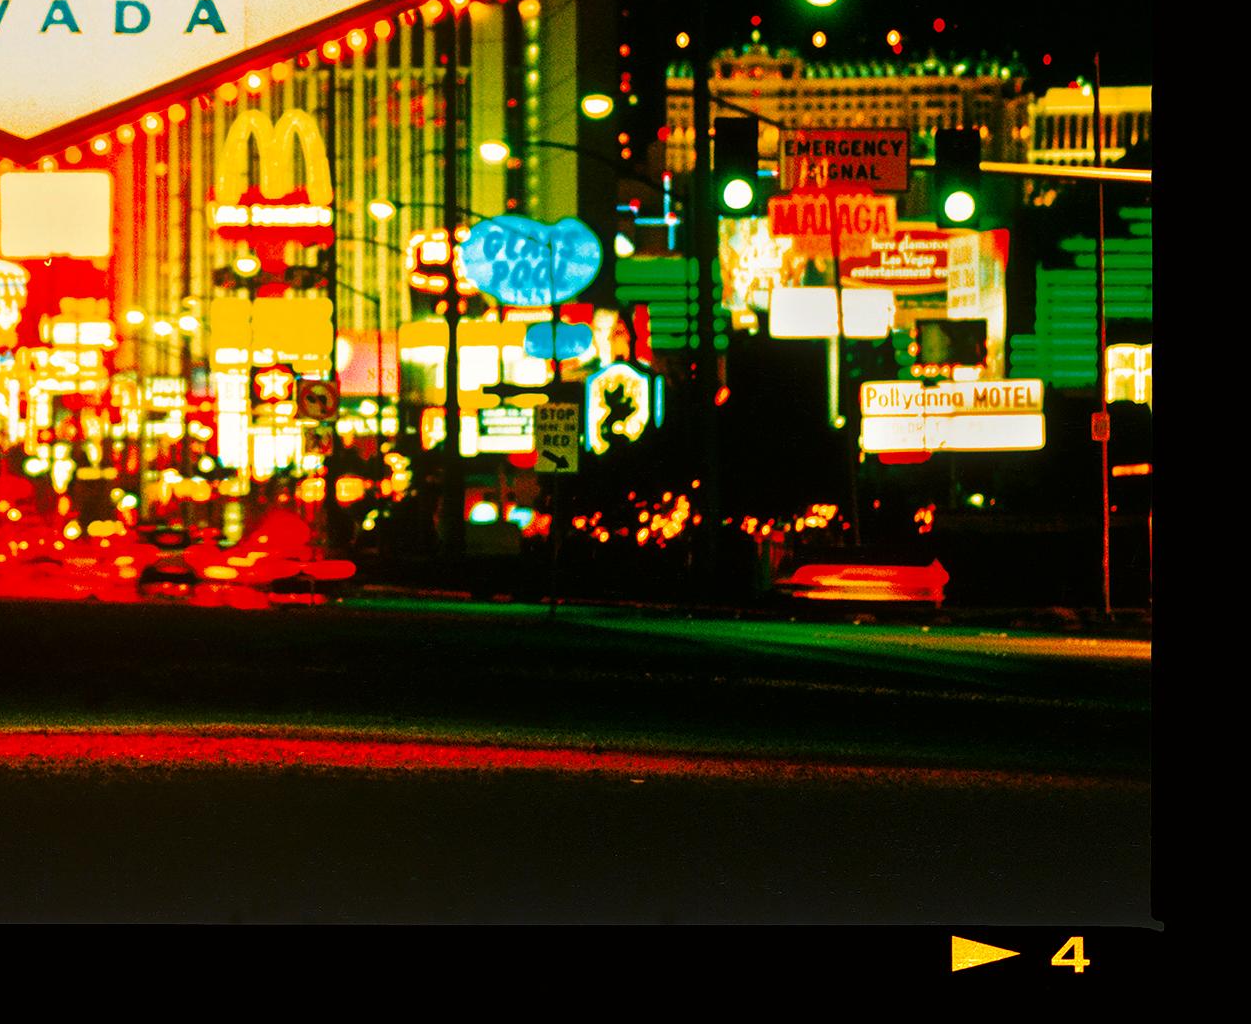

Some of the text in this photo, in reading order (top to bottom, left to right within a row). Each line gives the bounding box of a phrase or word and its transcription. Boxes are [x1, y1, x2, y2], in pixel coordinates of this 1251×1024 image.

[784, 139, 904, 157] EMERGENCY
[881, 252, 935, 267] Las Vegas
[865, 386, 1038, 410] Pollyanna MOTEL
[539, 408, 576, 420] STOP
